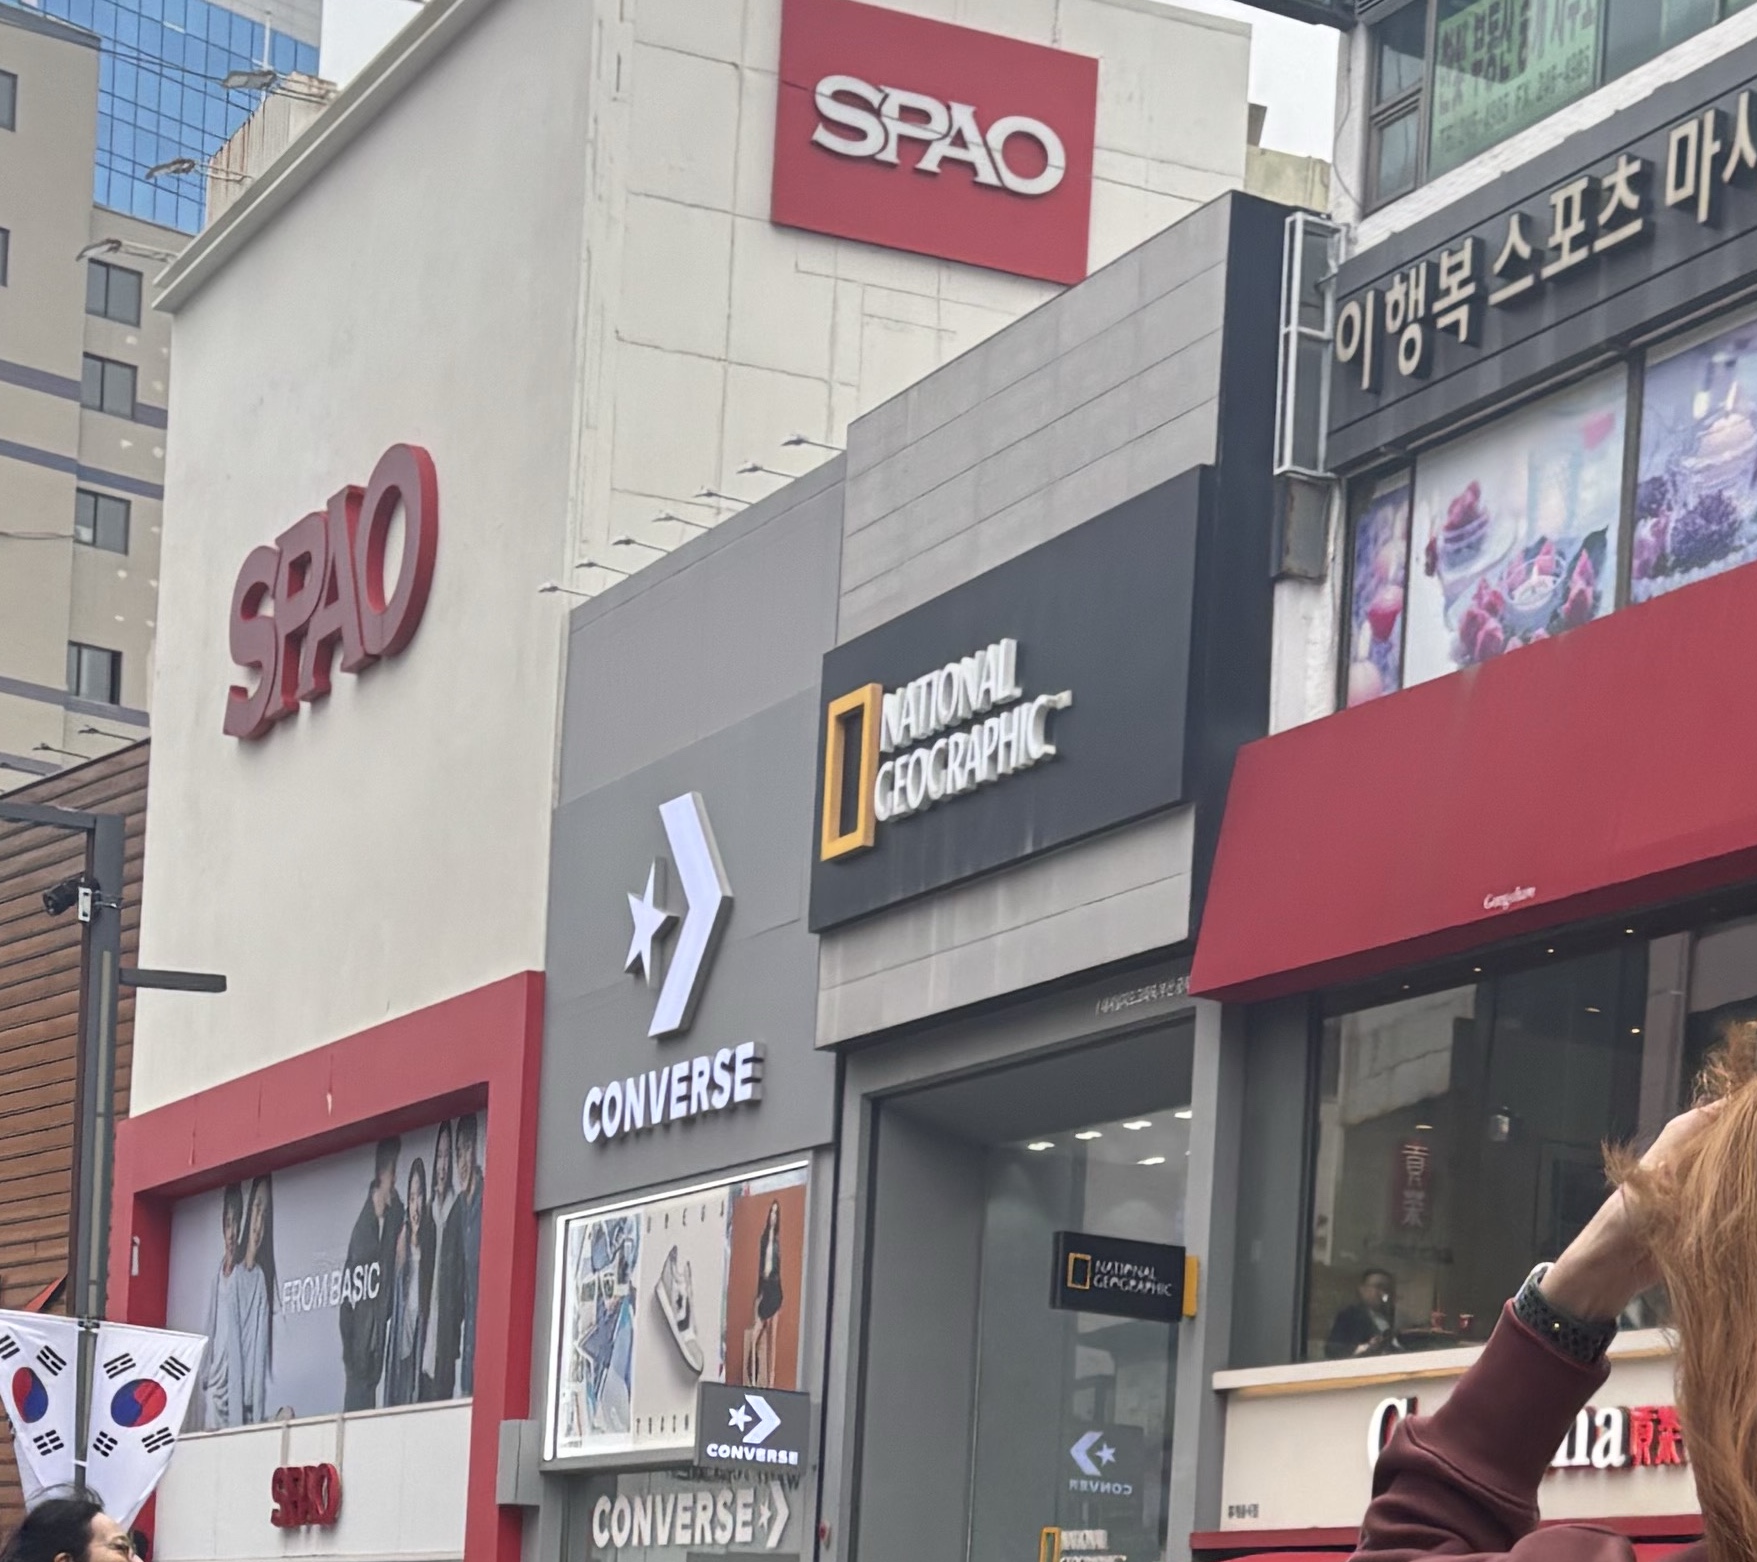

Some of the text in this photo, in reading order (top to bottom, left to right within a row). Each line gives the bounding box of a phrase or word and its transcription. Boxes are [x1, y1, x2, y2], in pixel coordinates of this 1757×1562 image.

[812, 73, 1068, 196] SPAO
[1336, 237, 1476, 390] 이행복
[1489, 155, 1645, 306] 스포츠
[222, 442, 439, 741] SPAO
[880, 637, 1022, 753] NATIONAL
[873, 694, 1058, 822] GEOGRAPHIC
[582, 1041, 760, 1144] CONVERSE
[282, 1261, 380, 1314] FROM BASIC
[1093, 1274, 1172, 1297] GEOGRAPHIC
[1094, 1260, 1156, 1281] NATIONAL
[706, 1443, 799, 1466] CONVERSE
[1551, 1407, 1626, 1468] ha
[592, 1487, 754, 1549] CONVERSE
